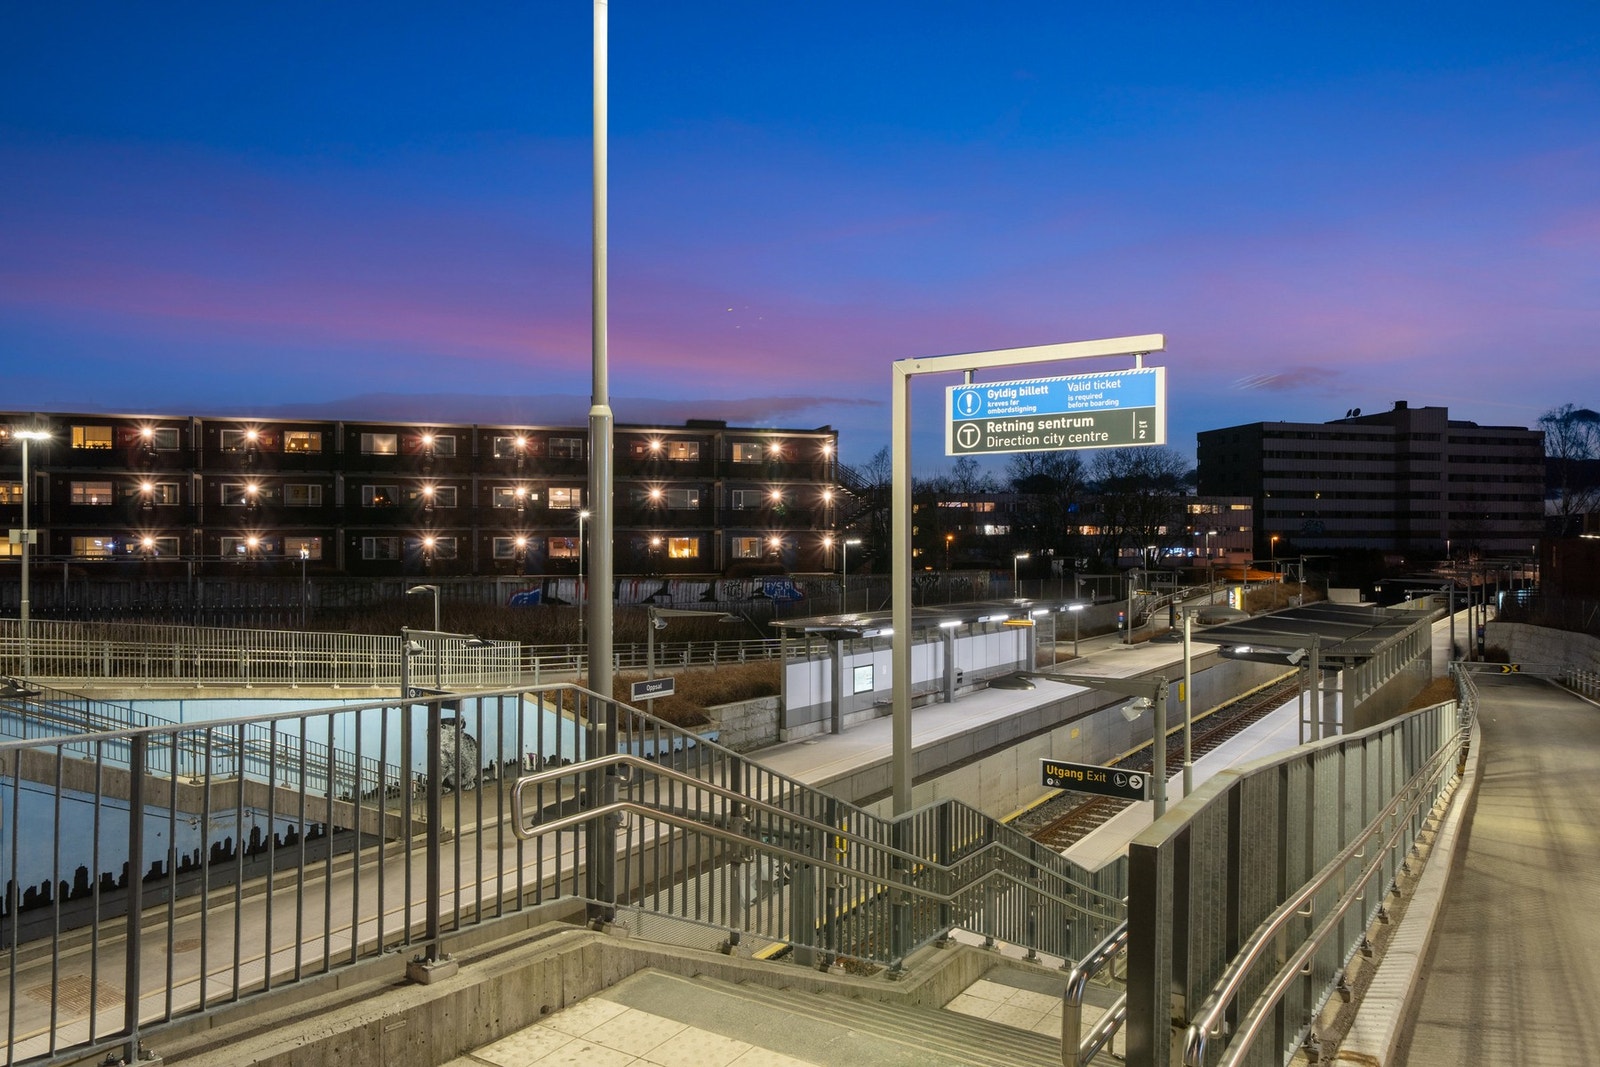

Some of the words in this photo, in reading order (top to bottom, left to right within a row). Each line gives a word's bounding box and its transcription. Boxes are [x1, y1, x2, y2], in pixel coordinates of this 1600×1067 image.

[1067, 381, 1091, 392] Valid
[1094, 379, 1121, 390] ticket
[987, 387, 1017, 400] Gyldig
[1019, 385, 1049, 396] billett
[1075, 392, 1103, 402] required
[1067, 400, 1089, 409] before
[1090, 399, 1120, 407] boarding
[987, 405, 1037, 415] ombordstigning
[986, 420, 1035, 433] Retning
[1037, 417, 1094, 429] sentrum
[986, 434, 1040, 448] Direction
[1043, 432, 1065, 446] city
[1068, 431, 1109, 443] centre
[1138, 429, 1146, 439] 2
[646, 682, 663, 692] Oppsal
[1046, 764, 1084, 781] Utgang
[1086, 770, 1107, 783] Exit
